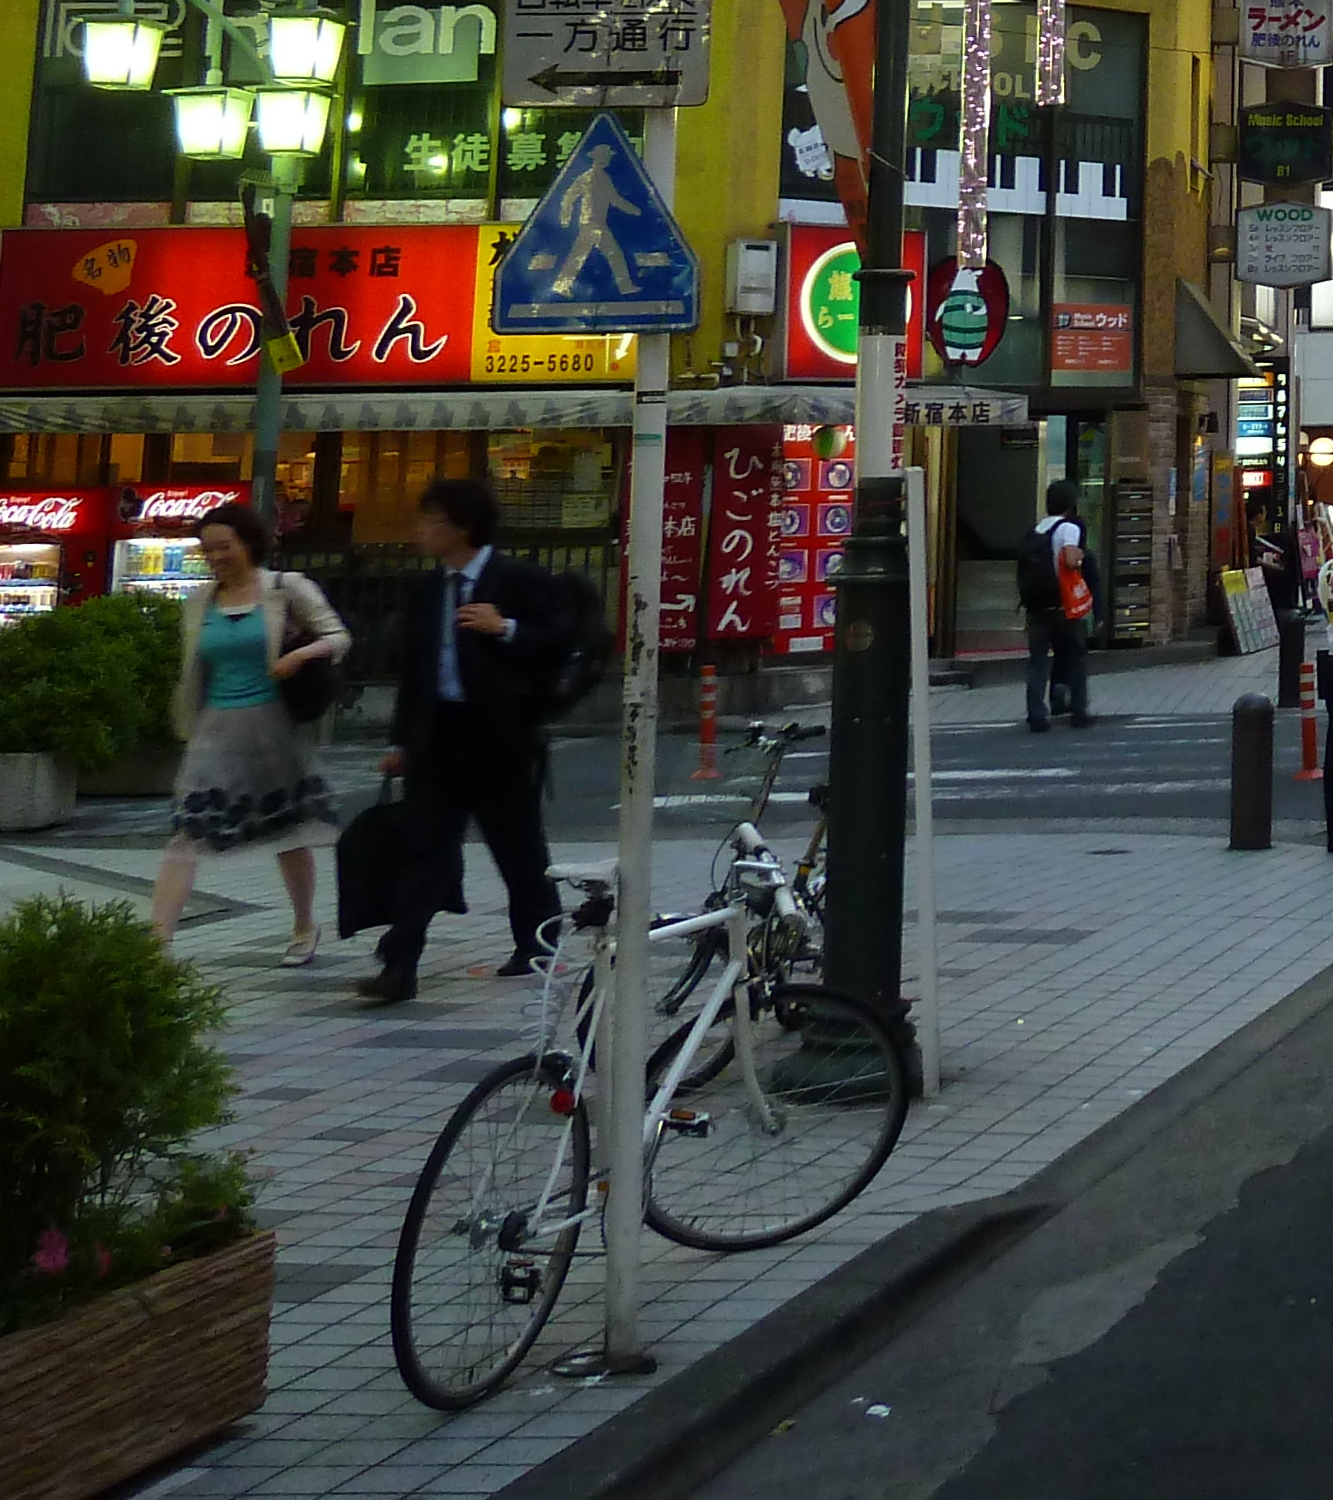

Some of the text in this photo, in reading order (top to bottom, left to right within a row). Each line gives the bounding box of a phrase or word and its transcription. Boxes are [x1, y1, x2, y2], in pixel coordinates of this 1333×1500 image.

[1247, 7, 1326, 32] ラーメン
[516, 15, 697, 54] 一方通行
[1251, 32, 1320, 48] 肥後のれん
[1256, 209, 1315, 222] WOOD
[1095, 312, 1129, 328] ウッド
[13, 292, 449, 367] 肥後のれん
[484, 354, 595, 374] 3225-5680
[1276, 373, 1287, 386] 9
[903, 401, 991, 424] 新宿本店
[1276, 405, 1287, 419] 7
[1276, 438, 1287, 451] 5
[716, 447, 765, 633] ひごのれん
